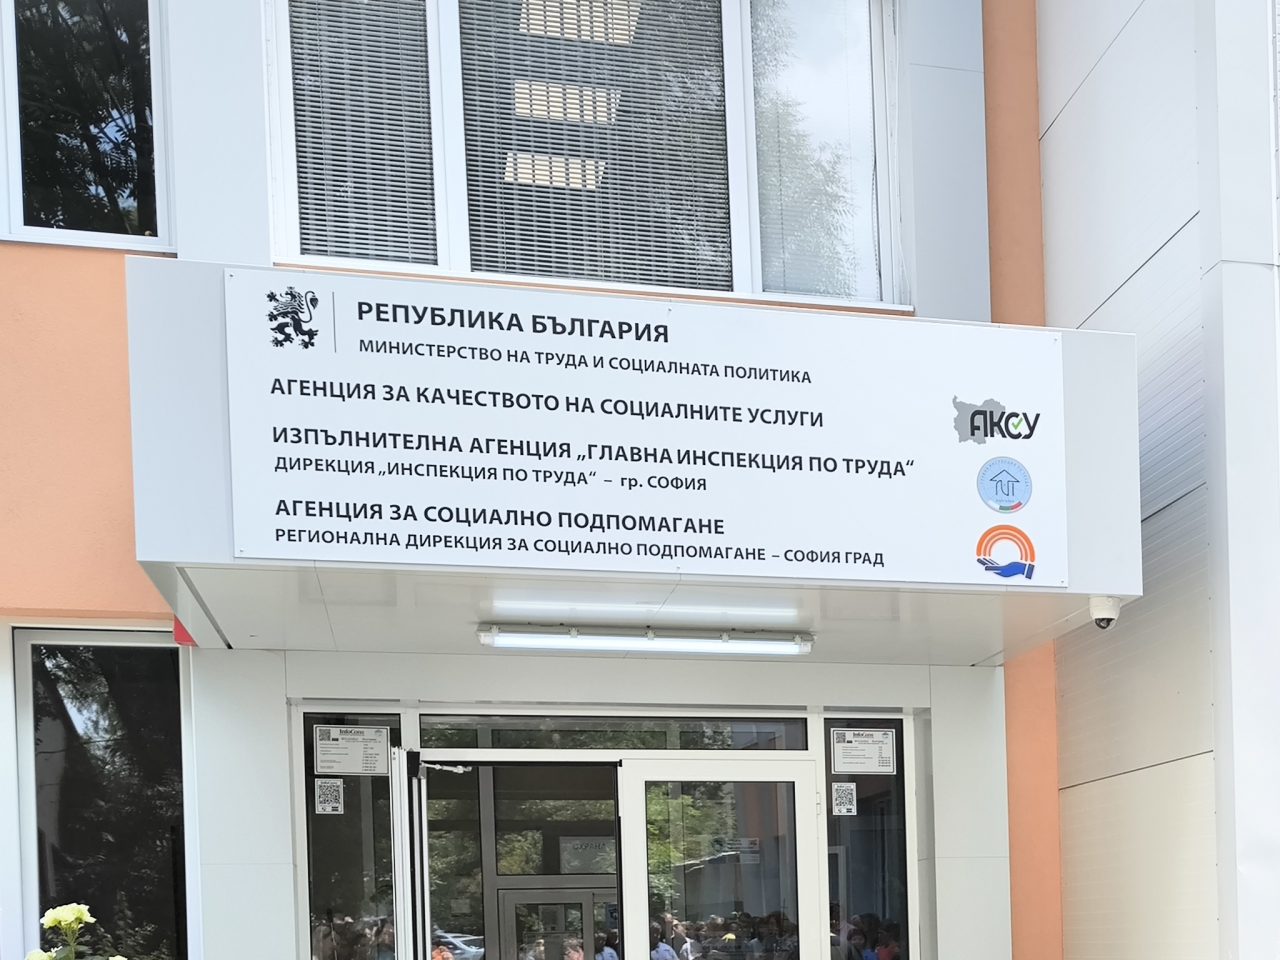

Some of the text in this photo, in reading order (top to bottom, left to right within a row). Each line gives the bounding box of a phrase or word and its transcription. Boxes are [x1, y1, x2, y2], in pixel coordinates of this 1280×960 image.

[358, 301, 669, 343] РЕПУБЛИКА БЪЛГАРИЯ
[359, 339, 812, 384] МИНИСТЕРСТВО НА ТРУДА И СОЦИАЛНАТА ПОЛИТИКА
[270, 378, 823, 428] АГЕНЦИЯ ЗА КАЧЕСТВОТО НА СОЦИАЛНИТЕ УСЛУГИ
[970, 409, 1040, 440] АКСУ
[272, 426, 914, 480] ИЗПЪЛНИТЕЛНА АГЕНЦИЯ „ГЛАВНА ИНСПЕКЦИЯ ПО ТРУДА“
[274, 456, 375, 476] ДИРЕКЦИЯ
[378, 461, 497, 482] „ИНСПЕКЦИЯ
[502, 467, 528, 482] ПО
[532, 470, 597, 487] ТРУДА“
[620, 476, 643, 491] гр.
[647, 475, 707, 491] СОФИЯ
[275, 499, 725, 535] АГЕНЦИЯ ЗА СОЦИАЛНО ПОДПОМАГАНЕ
[275, 528, 401, 547] РЕГИОНАЛНА
[405, 533, 502, 553] ДИРЕКЦИЯ
[507, 537, 529, 552] ЗА
[533, 539, 633, 557] СОЦИАЛНО
[637, 543, 766, 561] ПОДПОМАГАНЕ
[783, 549, 841, 564] СОФИЯ
[845, 551, 885, 568] ГРАД
